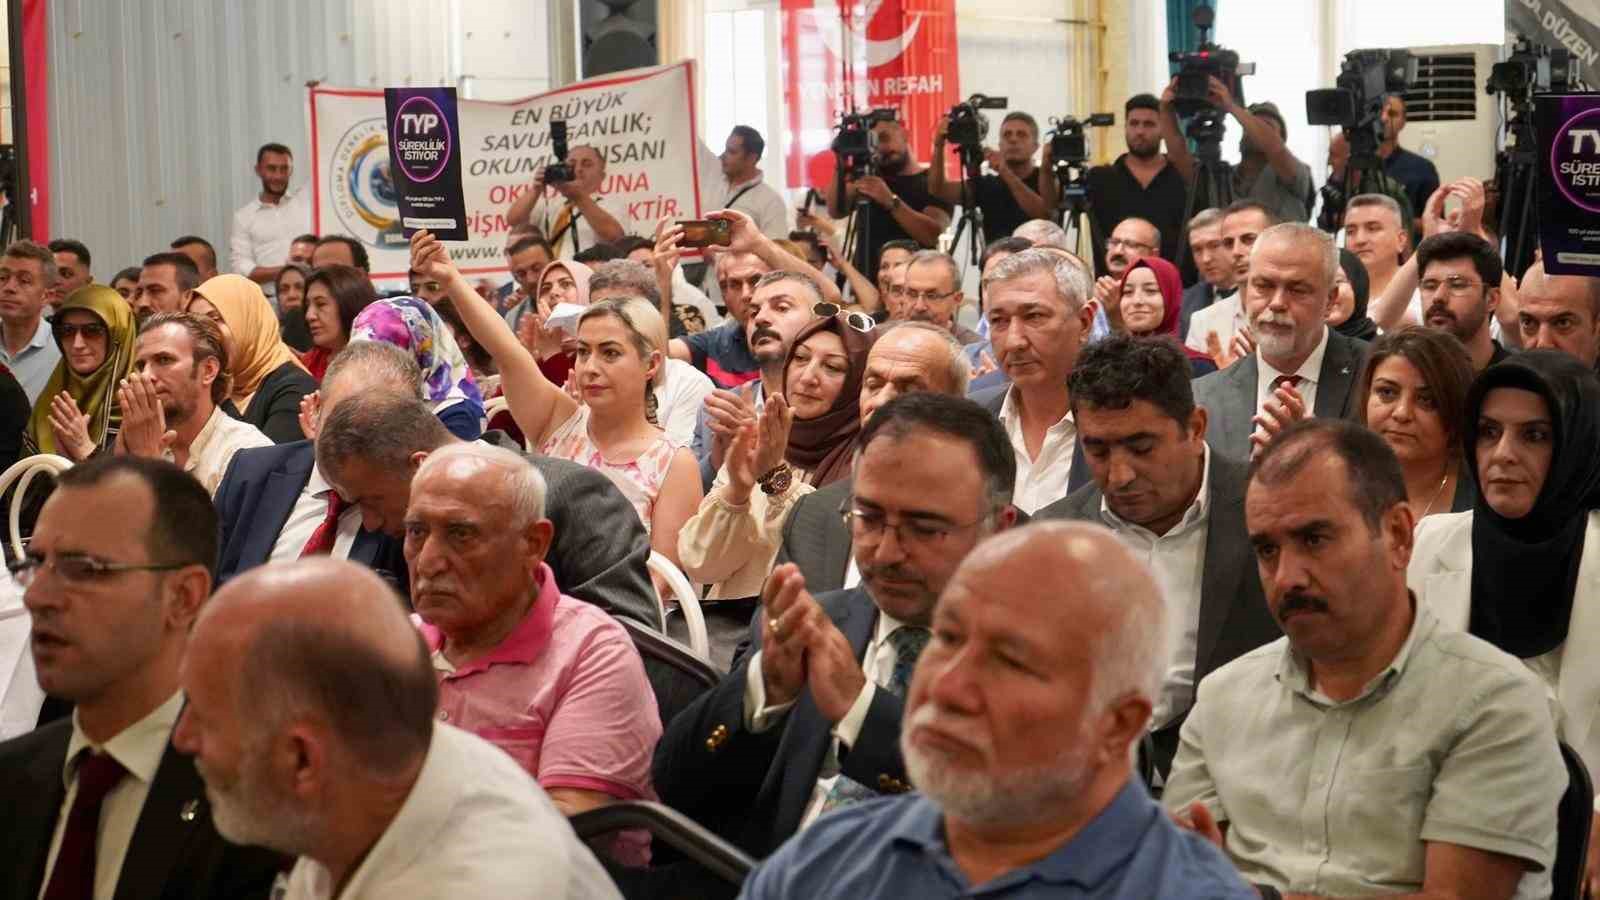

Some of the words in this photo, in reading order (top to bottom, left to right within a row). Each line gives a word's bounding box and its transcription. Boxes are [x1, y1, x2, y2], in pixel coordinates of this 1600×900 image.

[1542, 10, 1599, 66] DÜZEN
[884, 74, 943, 96] REFAH
[511, 108, 542, 126] EN
[550, 91, 627, 120] BÜYÜK
[401, 113, 438, 134] TYP
